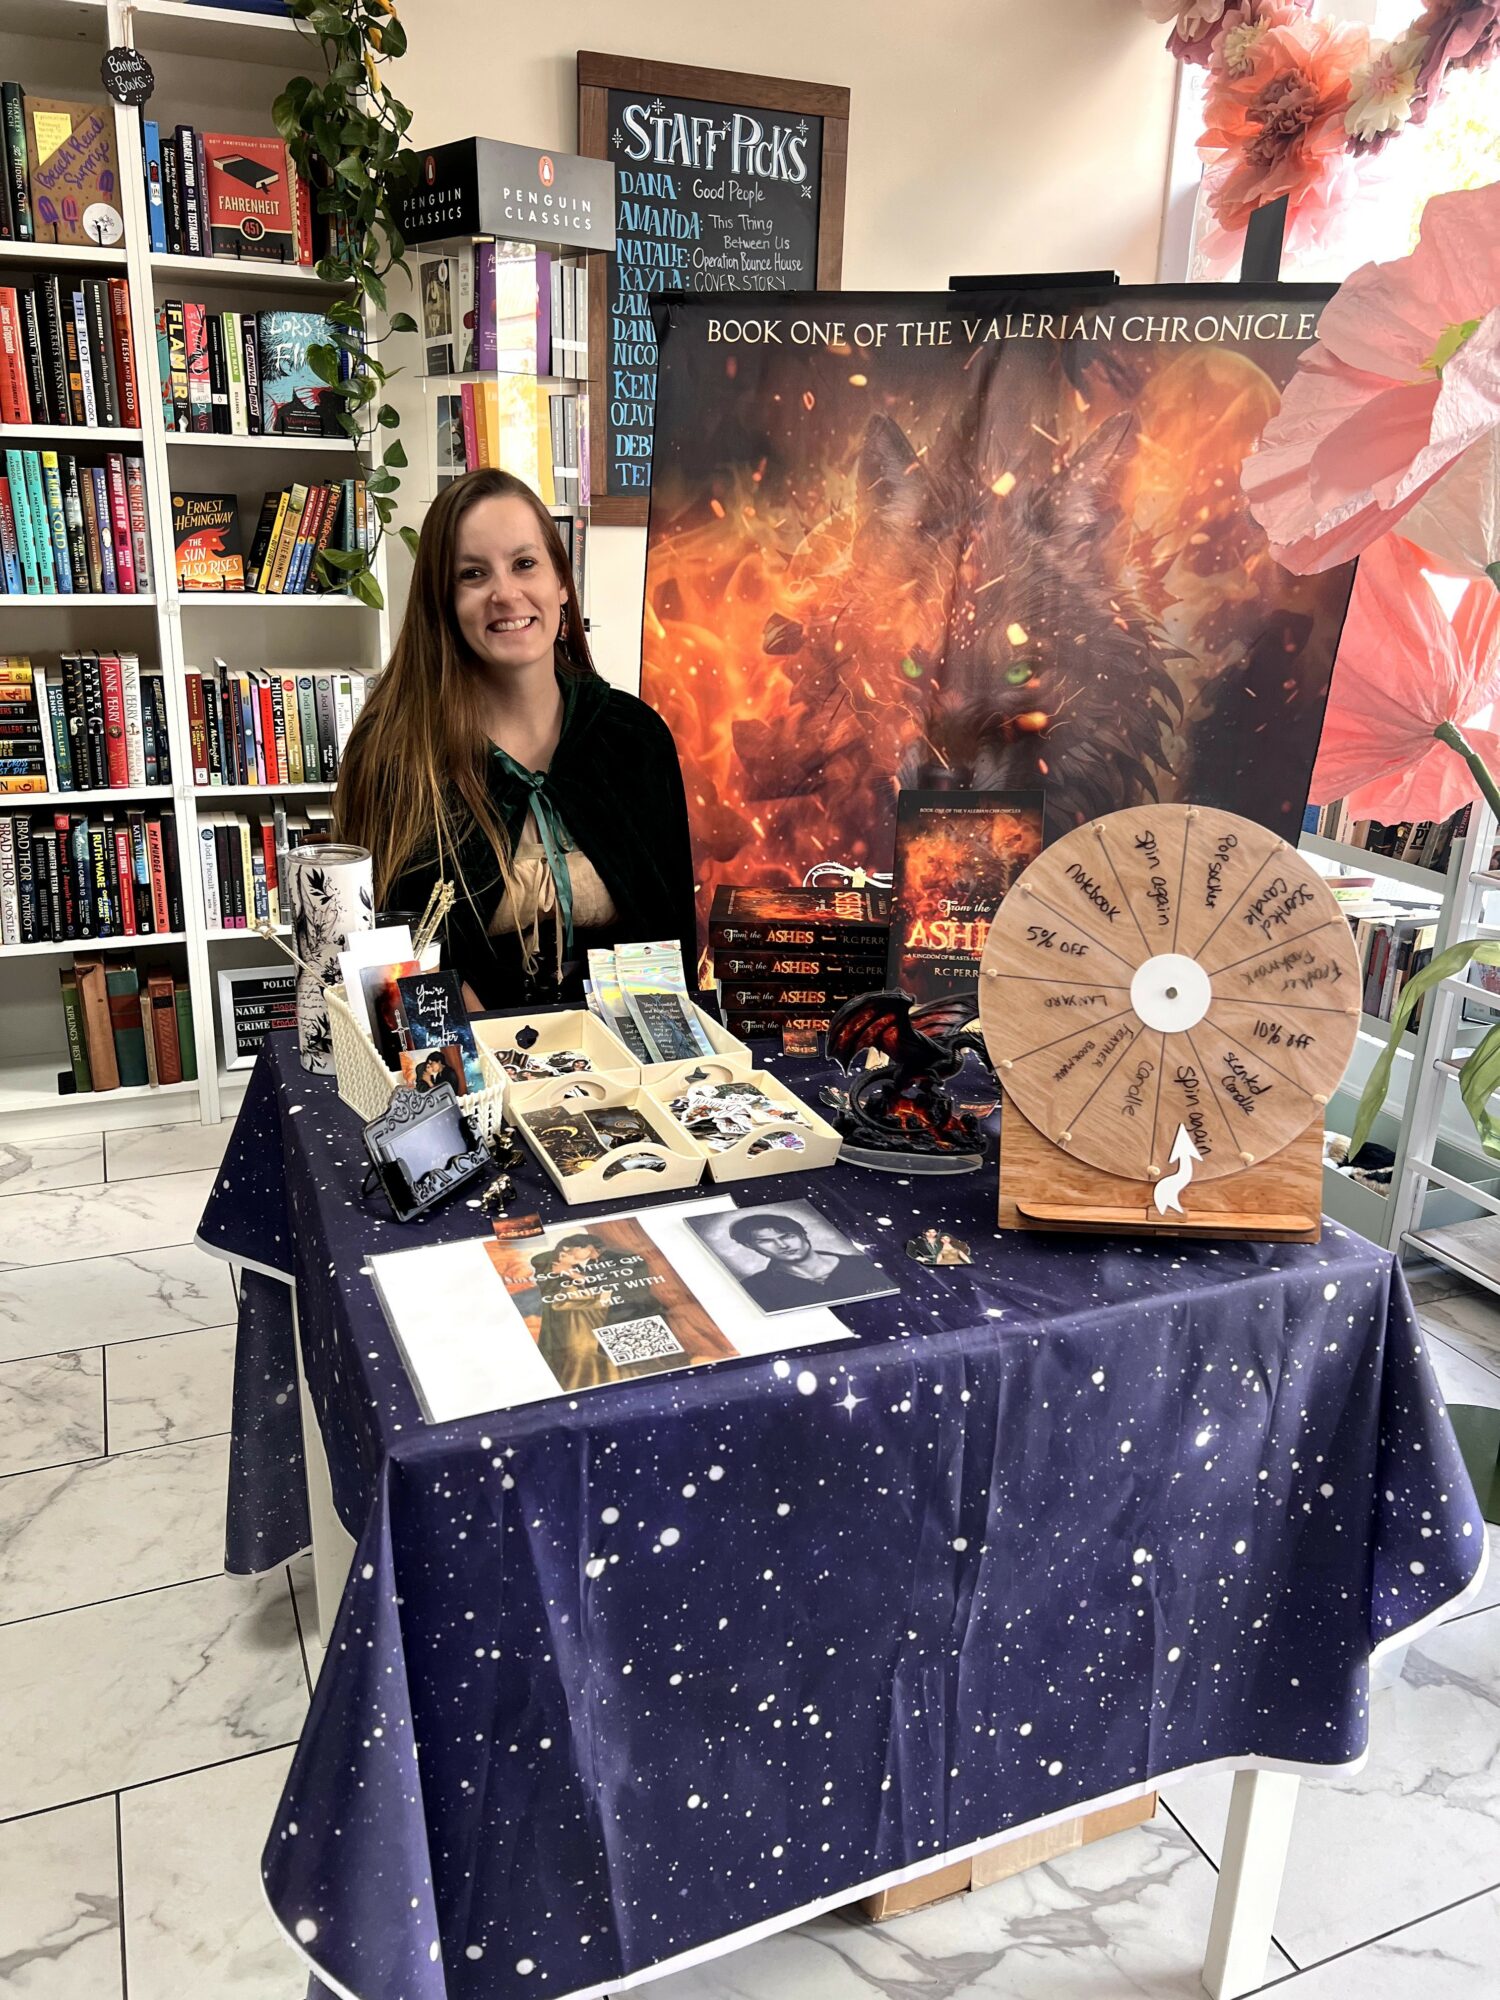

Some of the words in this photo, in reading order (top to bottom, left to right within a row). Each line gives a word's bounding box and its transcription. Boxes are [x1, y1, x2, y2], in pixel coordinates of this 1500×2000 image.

[107, 55, 145, 73] Banned
[115, 75, 147, 93] Books
[12, 97, 21, 133] CHARLES
[34, 149, 76, 190] Beach
[68, 114, 105, 155] Read
[623, 104, 726, 170] STAFF
[731, 113, 808, 185] PICKS
[64, 140, 110, 190] Surprise
[182, 130, 193, 162] MARGARET
[188, 211, 199, 252] TESTAMENTS
[403, 187, 462, 211] PENGUIN
[503, 187, 592, 213] PENGUIN
[619, 170, 682, 200] DANA:
[693, 178, 725, 200] Good
[729, 180, 766, 208] People
[218, 195, 280, 216] FAHRENHEIT
[404, 206, 462, 230] CLASSICS
[504, 206, 593, 231] CLASSICS
[243, 221, 260, 239] 451
[616, 200, 704, 240] AMANDA:
[708, 214, 734, 230] This
[738, 214, 773, 236] Thing
[616, 238, 691, 269] NATALIE:
[693, 248, 739, 273] Operation
[740, 252, 772, 271] Bounce
[774, 252, 804, 271] House
[724, 235, 770, 250] Between
[775, 237, 791, 250] Us
[694, 272, 740, 292] COVER
[742, 275, 786, 292] STORY
[44, 280, 55, 318] THOMAS
[75, 297, 85, 325] THE
[49, 320, 60, 356] HARRIS
[228, 319, 238, 357] INVISIBLE
[270, 315, 313, 338] LORD
[708, 319, 783, 344] BOOK
[790, 320, 847, 347] ONE
[853, 323, 889, 348] OF
[896, 320, 953, 347] THE
[961, 312, 1115, 343] VALERIAN
[78, 330, 90, 365] PLOT
[121, 338, 130, 363] FLESH
[168, 308, 188, 399] FLAMER
[246, 344, 257, 385] CARNIVAL
[53, 361, 66, 411] HANNIBAL
[125, 382, 135, 410] BLOOD
[85, 385, 95, 422] HITCHCOCK
[479, 438, 488, 465] EMMA
[130, 484, 143, 512] SILVER
[187, 499, 223, 514] ERNEST
[52, 511, 66, 549] COLD
[175, 512, 234, 531] HEMINGWAY
[181, 547, 207, 563] SUN
[189, 538, 202, 547] THE
[575, 533, 585, 567] Rebecca
[73, 542, 81, 573] HAWKINS
[181, 562, 207, 577] ALSO
[208, 558, 239, 573] RISES
[275, 553, 287, 578] RUNNER
[73, 669, 85, 711] ANNE
[83, 662, 95, 715] PERRY
[91, 668, 102, 710] ANNE
[104, 665, 117, 694] ANNE
[123, 664, 136, 691] ANNE
[49, 690, 58, 717] PENNY
[55, 689, 65, 717] LOUISE
[65, 664, 78, 720] PERRY
[106, 696, 120, 723] PERRY
[125, 694, 138, 722] PERRY
[144, 706, 152, 720] THE
[55, 720, 65, 741] STILL
[145, 726, 154, 748] DARE
[287, 713, 297, 742] Picoult
[305, 713, 313, 741] Picoult
[323, 714, 331, 742] Picoult
[57, 742, 66, 758] LIFE
[209, 727, 221, 767] Mockingbird
[0, 823, 11, 852] BRAD
[16, 820, 29, 849] BRAD
[92, 834, 103, 860] RUTH
[132, 824, 141, 843] KATE
[58, 832, 68, 865] Dearest
[151, 843, 162, 873] MURDER
[1135, 829, 1160, 870] Spin
[1, 855, 15, 888] THOR
[19, 850, 32, 882] THOR
[95, 860, 106, 889] WARE
[134, 844, 144, 882] WILHELM
[206, 862, 214, 893] Picoult
[21, 894, 33, 932] PATRIOT
[835, 890, 864, 921] ASHES
[938, 898, 972, 918] From
[974, 901, 990, 914] the
[1146, 876, 1170, 926] again
[5, 901, 15, 933] APOSTLE
[723, 928, 747, 943] From
[750, 931, 761, 939] the
[765, 929, 814, 944] ASHES
[1027, 925, 1057, 948] 5%
[1060, 941, 1090, 956] OFF
[729, 959, 754, 974] From
[756, 961, 767, 970] the
[771, 960, 820, 975] ASHES
[415, 983, 446, 1003] You're
[417, 996, 449, 1018] beautiful
[736, 991, 760, 1005] From
[762, 992, 774, 1001] the
[778, 991, 826, 1004] ASHES
[1044, 994, 1108, 1008] LANYARD
[235, 1006, 266, 1016] NAME
[237, 1021, 271, 1032] CRIME
[425, 1029, 459, 1047] brighter
[741, 1020, 766, 1033] From
[767, 1021, 779, 1029] the
[785, 1019, 830, 1032] ASHES
[1253, 1020, 1283, 1045] 10%
[72, 1043, 82, 1062] BEST
[786, 1045, 817, 1053] ASHES
[1091, 1023, 1135, 1069] FEATHER
[1173, 1065, 1200, 1108] Spin
[1186, 1112, 1213, 1156] again
[536, 1266, 581, 1283] SCAN
[585, 1257, 617, 1273] THE
[619, 1254, 644, 1265] QR
[560, 1272, 608, 1289] CODE
[609, 1267, 634, 1279] TO
[541, 1283, 620, 1305] CONNECT
[624, 1274, 667, 1290] WITH
[600, 1295, 625, 1307] ME
